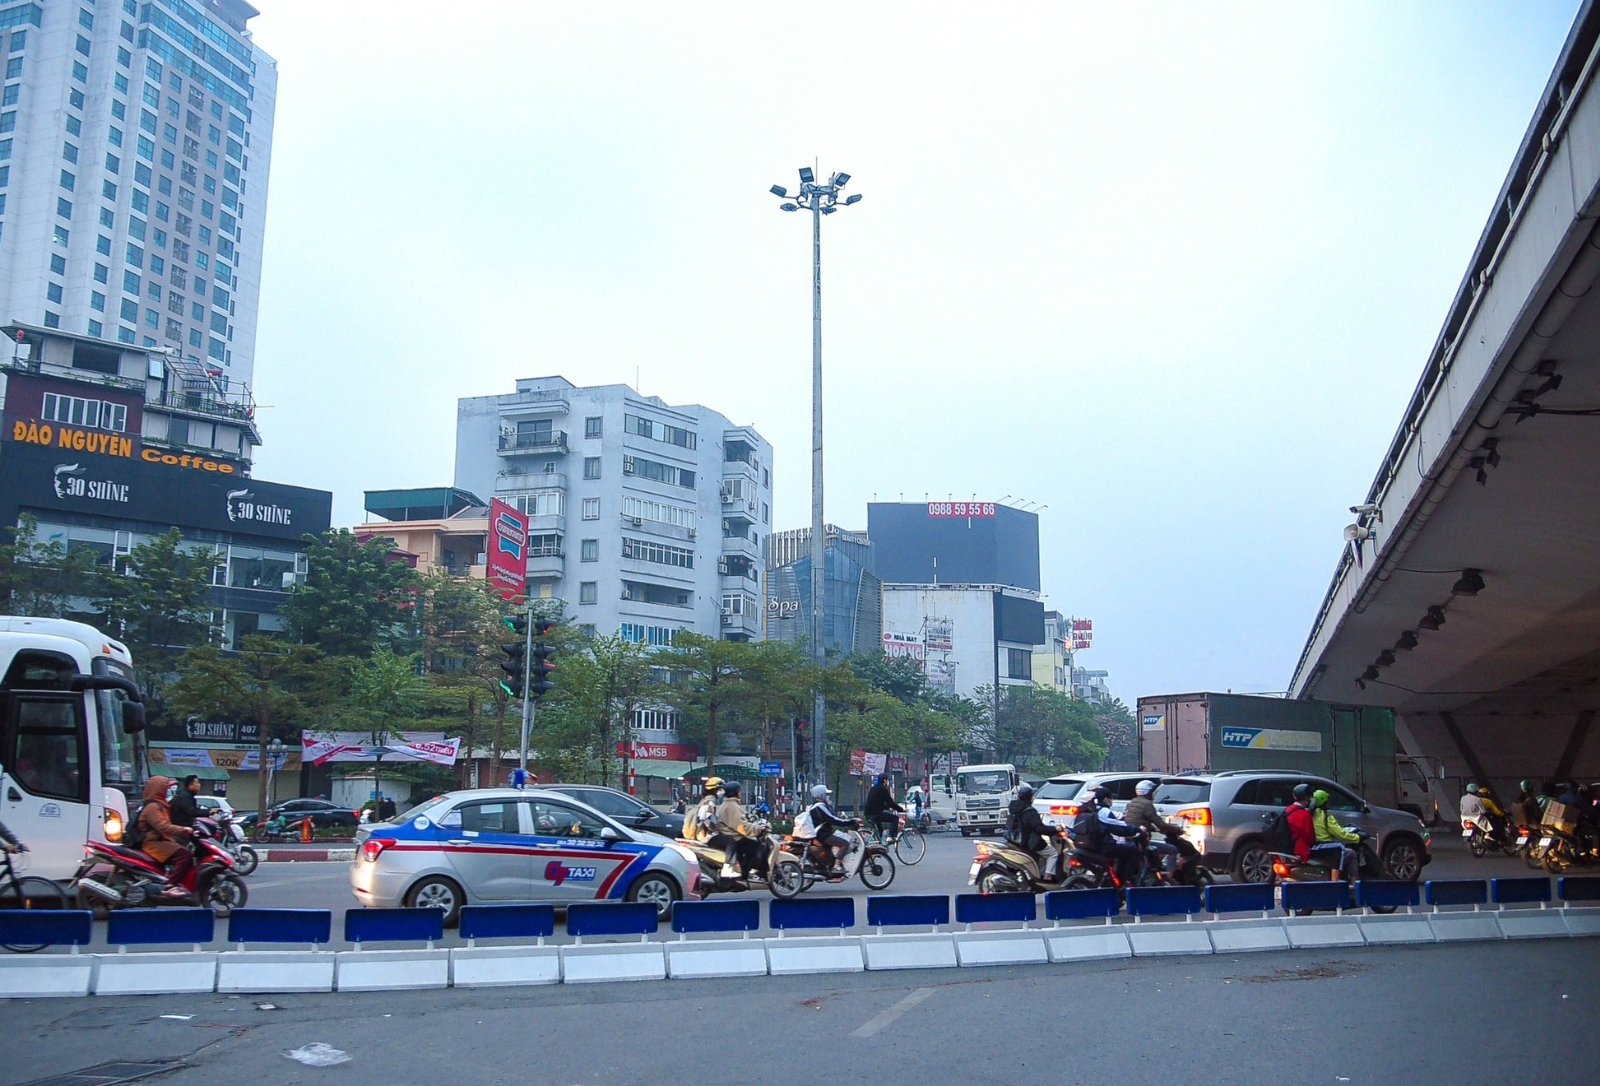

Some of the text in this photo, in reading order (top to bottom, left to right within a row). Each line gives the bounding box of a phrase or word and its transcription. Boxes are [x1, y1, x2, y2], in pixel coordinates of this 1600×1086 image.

[13, 418, 132, 458] ĐÀO NGUYÊN
[141, 448, 234, 474] Coffee
[66, 477, 129, 502] 30 SHINE
[237, 503, 292, 525] 30 SHINE
[928, 503, 995, 515] 0988 59 55 66
[768, 595, 799, 617] Spa
[194, 722, 234, 737] 30 SHINE
[240, 725, 257, 734] 407
[1223, 732, 1252, 742] HTP
[648, 747, 667, 758] MSB
[215, 758, 239, 767] 120K
[568, 868, 595, 877] TAXI
